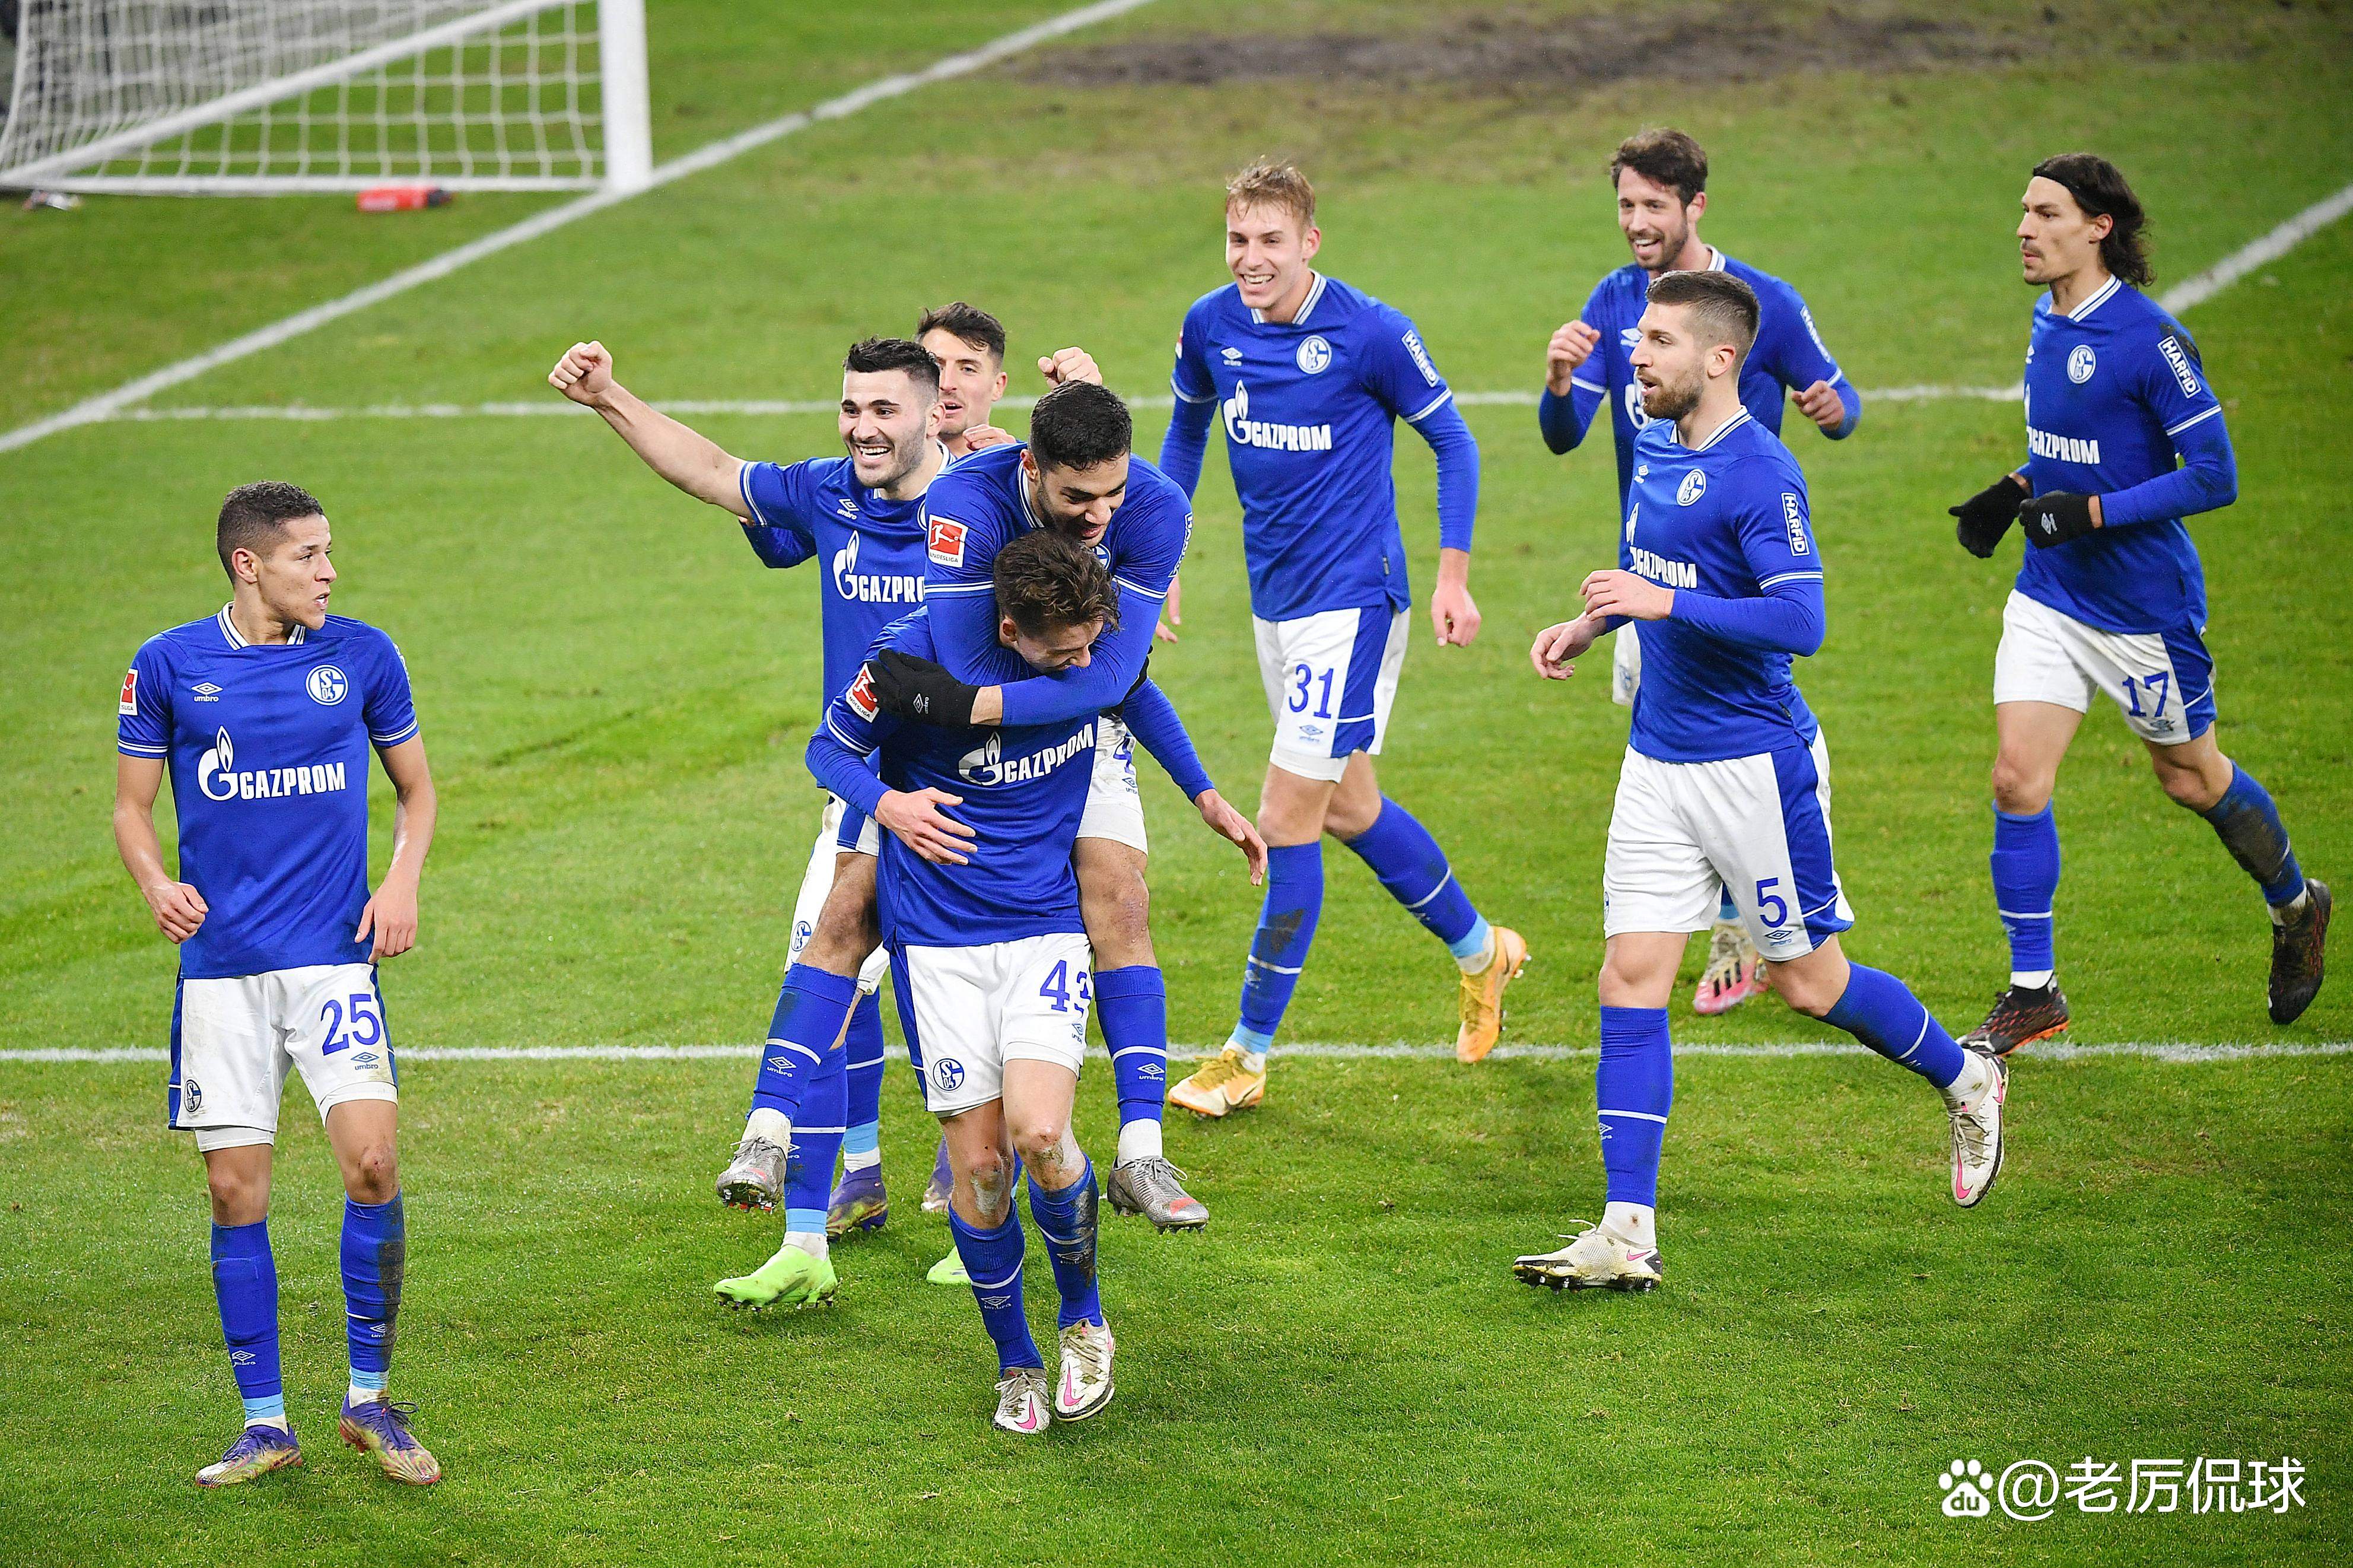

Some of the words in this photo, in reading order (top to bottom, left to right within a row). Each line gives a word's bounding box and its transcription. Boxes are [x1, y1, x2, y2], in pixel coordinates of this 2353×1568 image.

[1252, 422, 1332, 451] GAZPROM
[2032, 428, 2100, 465] GAZPROM
[837, 508, 857, 520] umbro
[1636, 549, 1697, 589] GAZPROM
[858, 575, 925, 603] GAZPRO
[1289, 664, 1334, 719] 31
[2122, 670, 2169, 717] 17
[1004, 723, 1094, 784] GAZPROM
[239, 762, 346, 800] GAZPROM
[1756, 877, 1788, 928] 5
[320, 993, 380, 1056] 25
[767, 1066, 793, 1077] umbro
